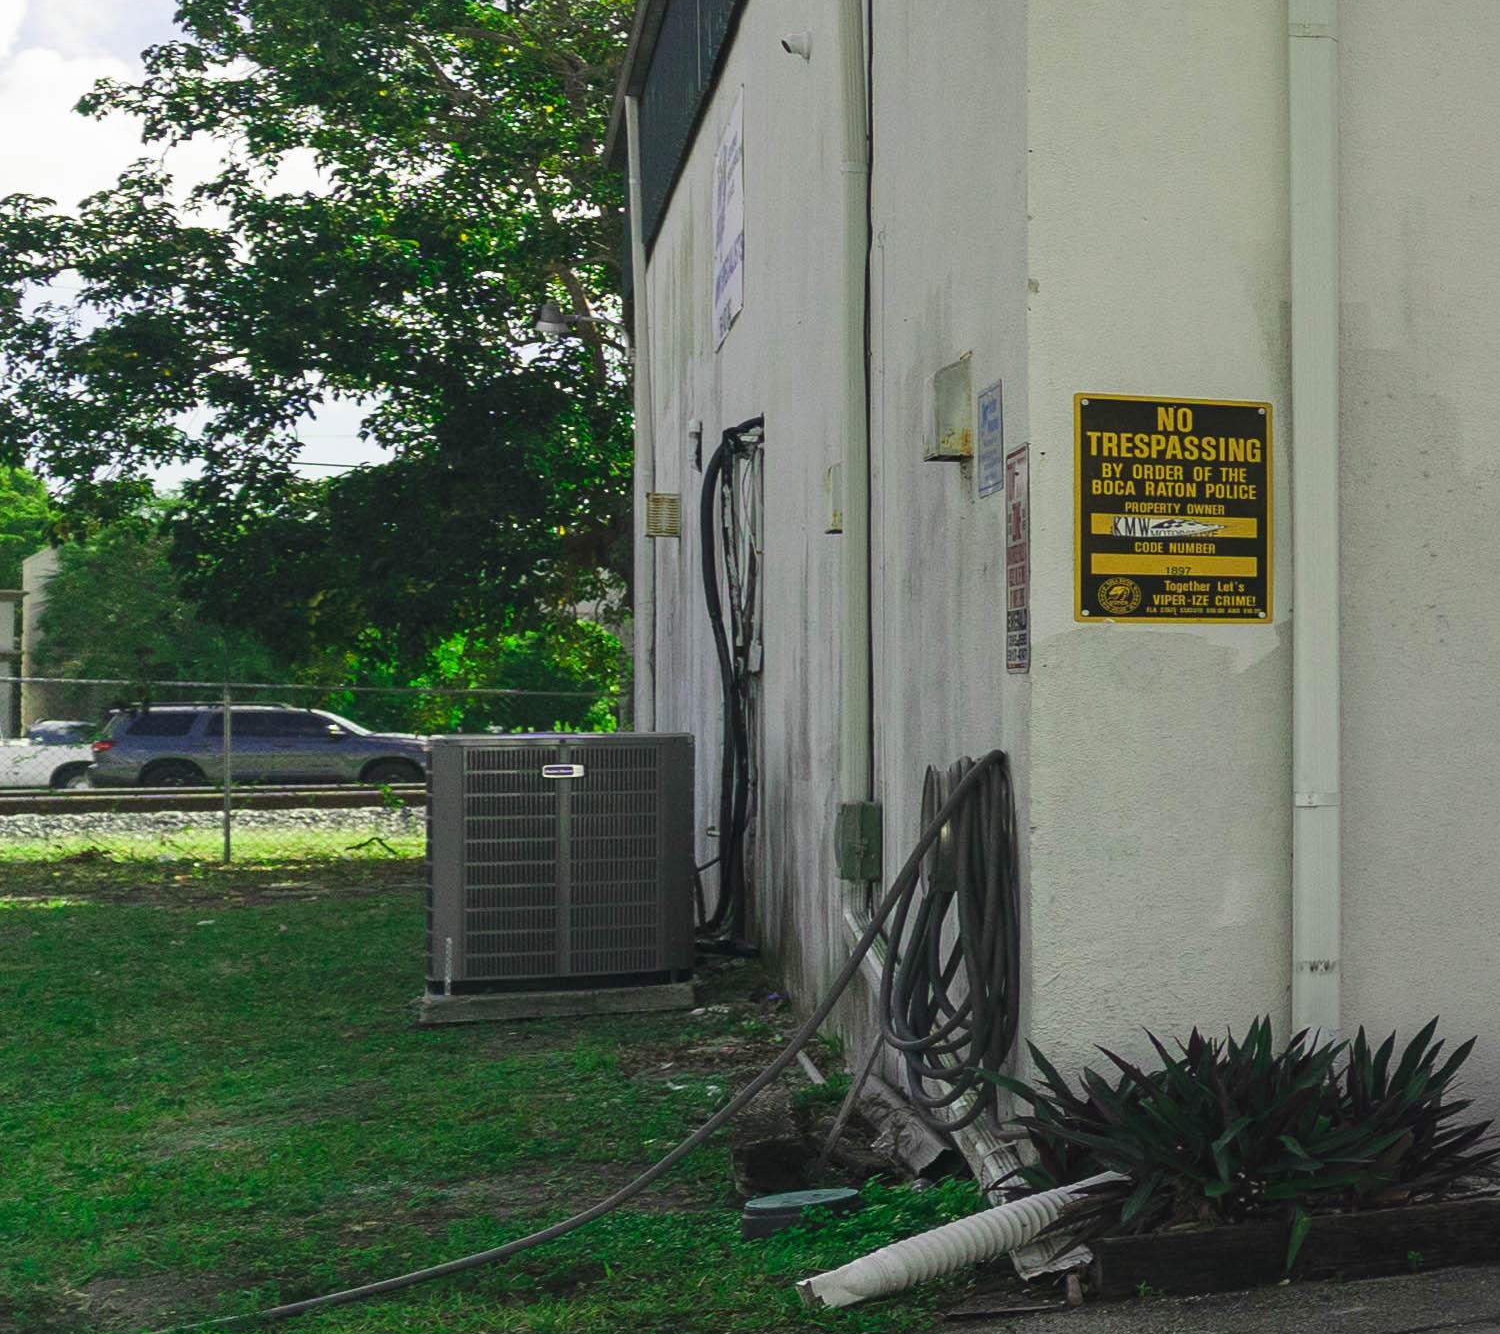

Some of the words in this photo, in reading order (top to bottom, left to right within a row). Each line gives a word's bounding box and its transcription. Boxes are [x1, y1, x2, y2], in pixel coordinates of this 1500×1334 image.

[1157, 406, 1193, 433] NO
[1086, 431, 1262, 462] TRESPASSING
[1102, 463, 1123, 478] BY
[1132, 464, 1183, 480] ORDER
[1193, 466, 1212, 482] OF
[1220, 467, 1247, 483] THE
[1092, 479, 1136, 495] BOCA
[1145, 482, 1197, 497] RATON
[1205, 484, 1257, 500] POLICE
[1125, 501, 1181, 514] PROPERTY
[1187, 503, 1225, 515] OWNER
[1113, 516, 1151, 537] KMW
[1134, 542, 1164, 553] CODE
[1169, 543, 1216, 554] NUMBER
[1165, 566, 1192, 576] 1897
[1164, 580, 1211, 593] Together
[1217, 581, 1245, 593] Let's
[1153, 594, 1210, 606] VIPER-IZE
[1215, 596, 1257, 607] CRIME!
